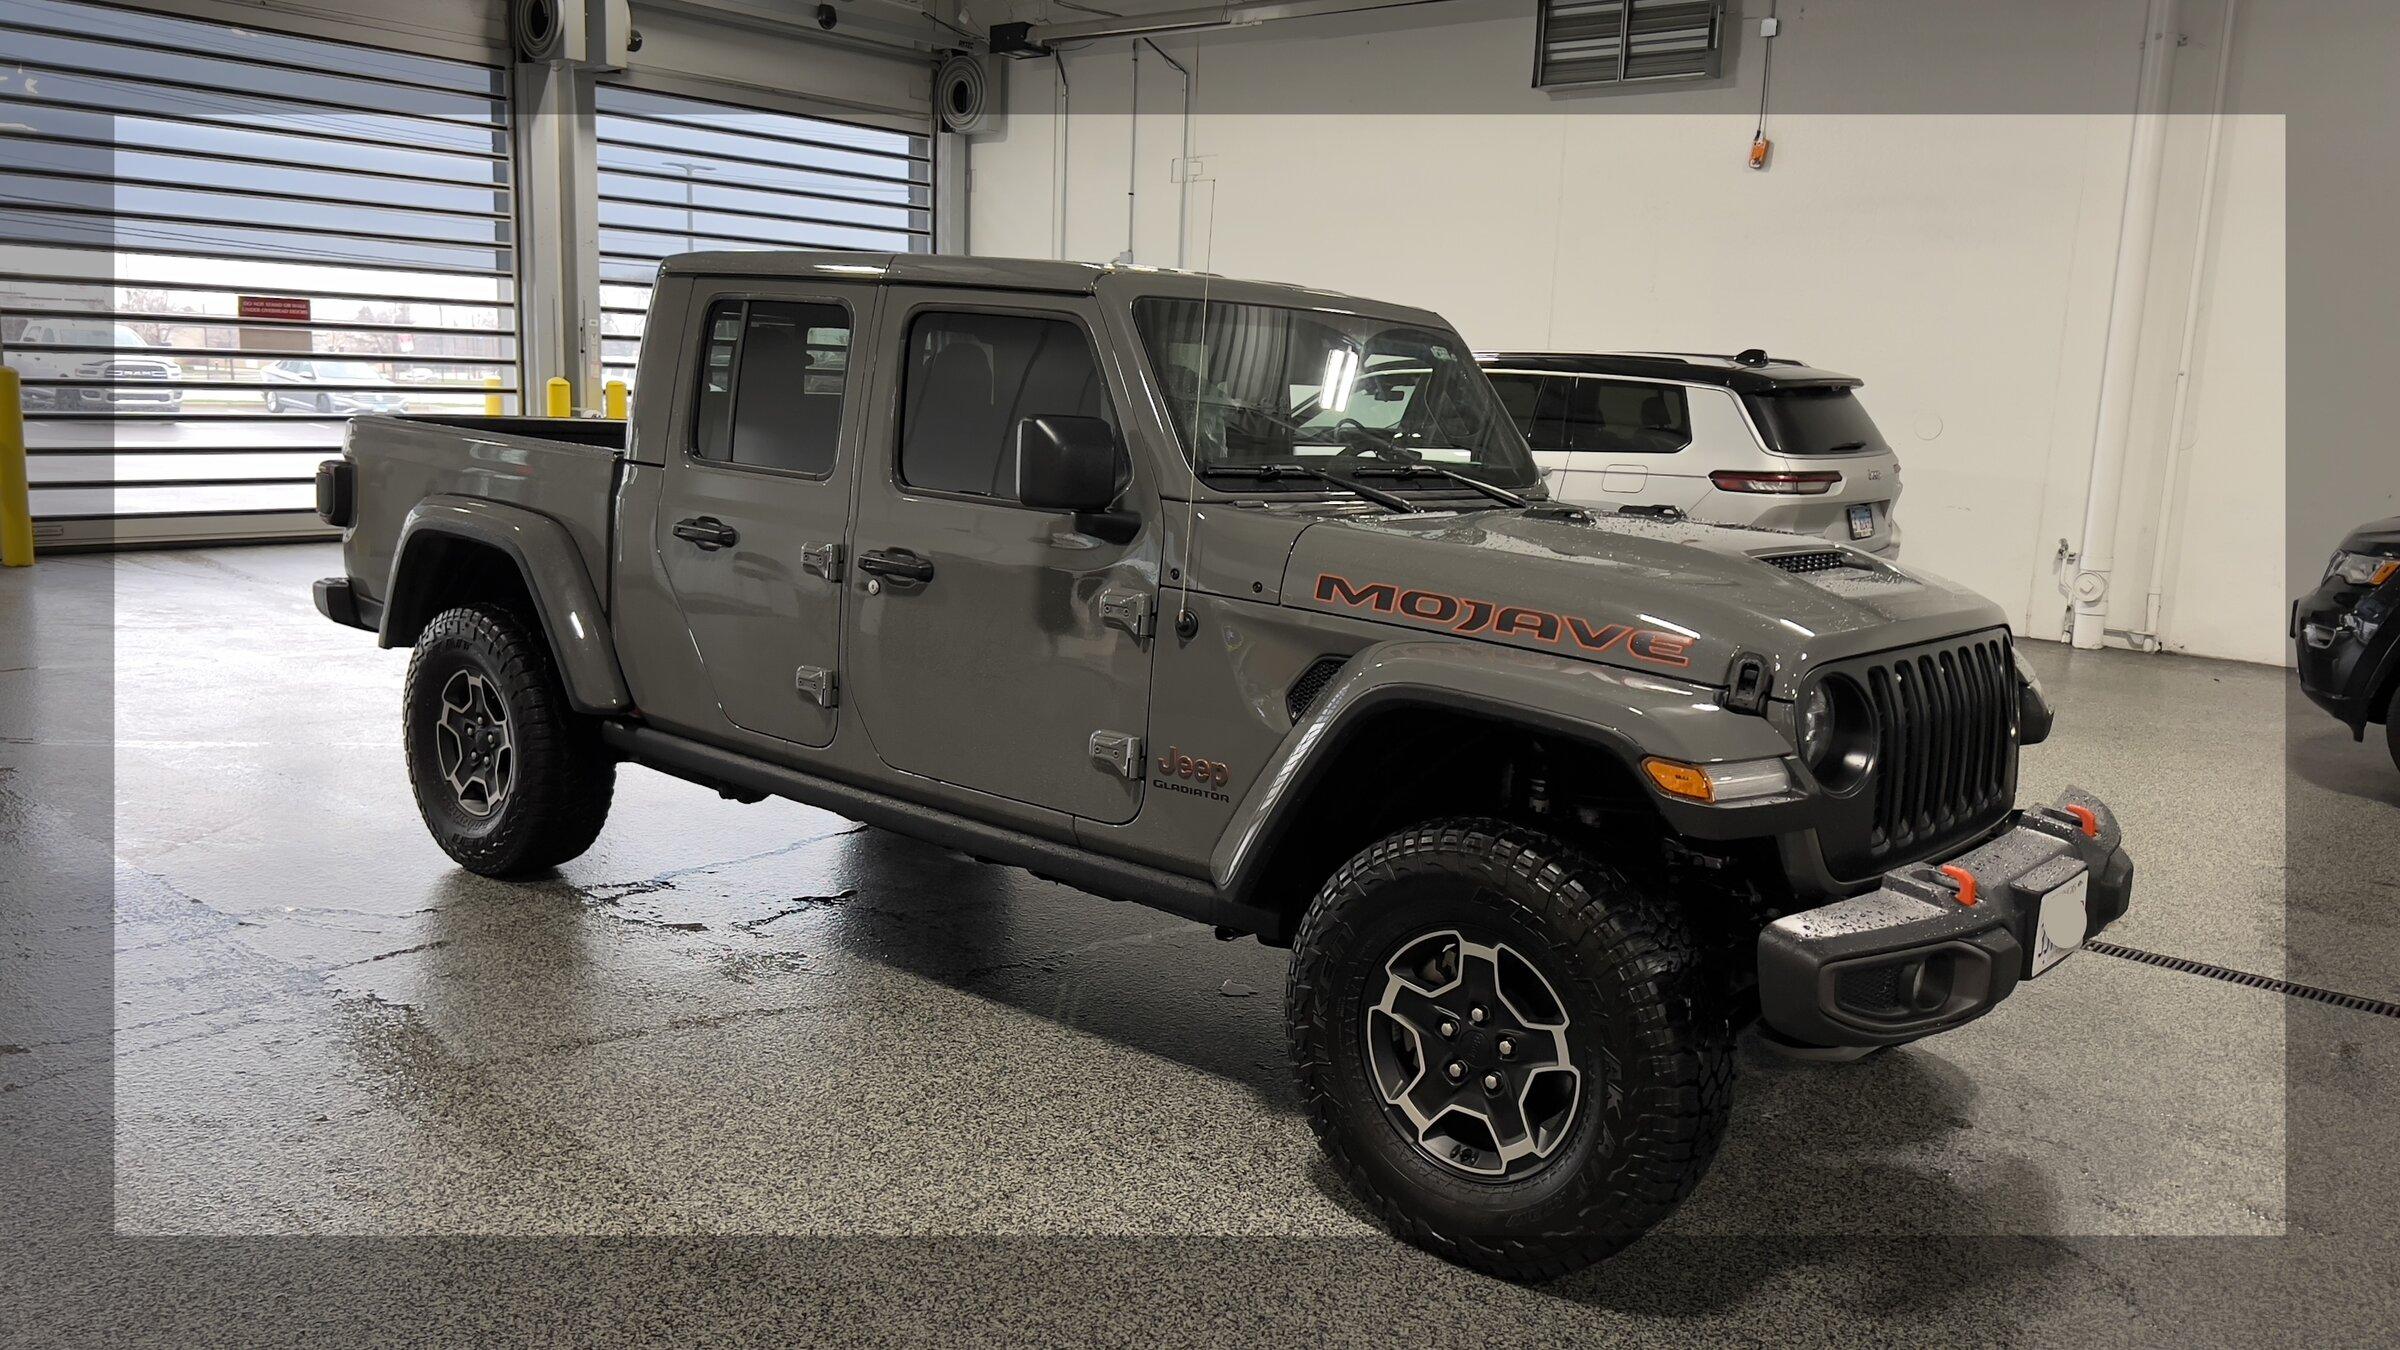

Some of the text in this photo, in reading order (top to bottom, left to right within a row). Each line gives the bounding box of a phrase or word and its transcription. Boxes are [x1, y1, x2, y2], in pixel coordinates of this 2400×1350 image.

[1314, 572, 1695, 668] MOJAVE
[1153, 779, 1230, 803] GLADIATOR
[1157, 745, 1229, 792] Jeep
